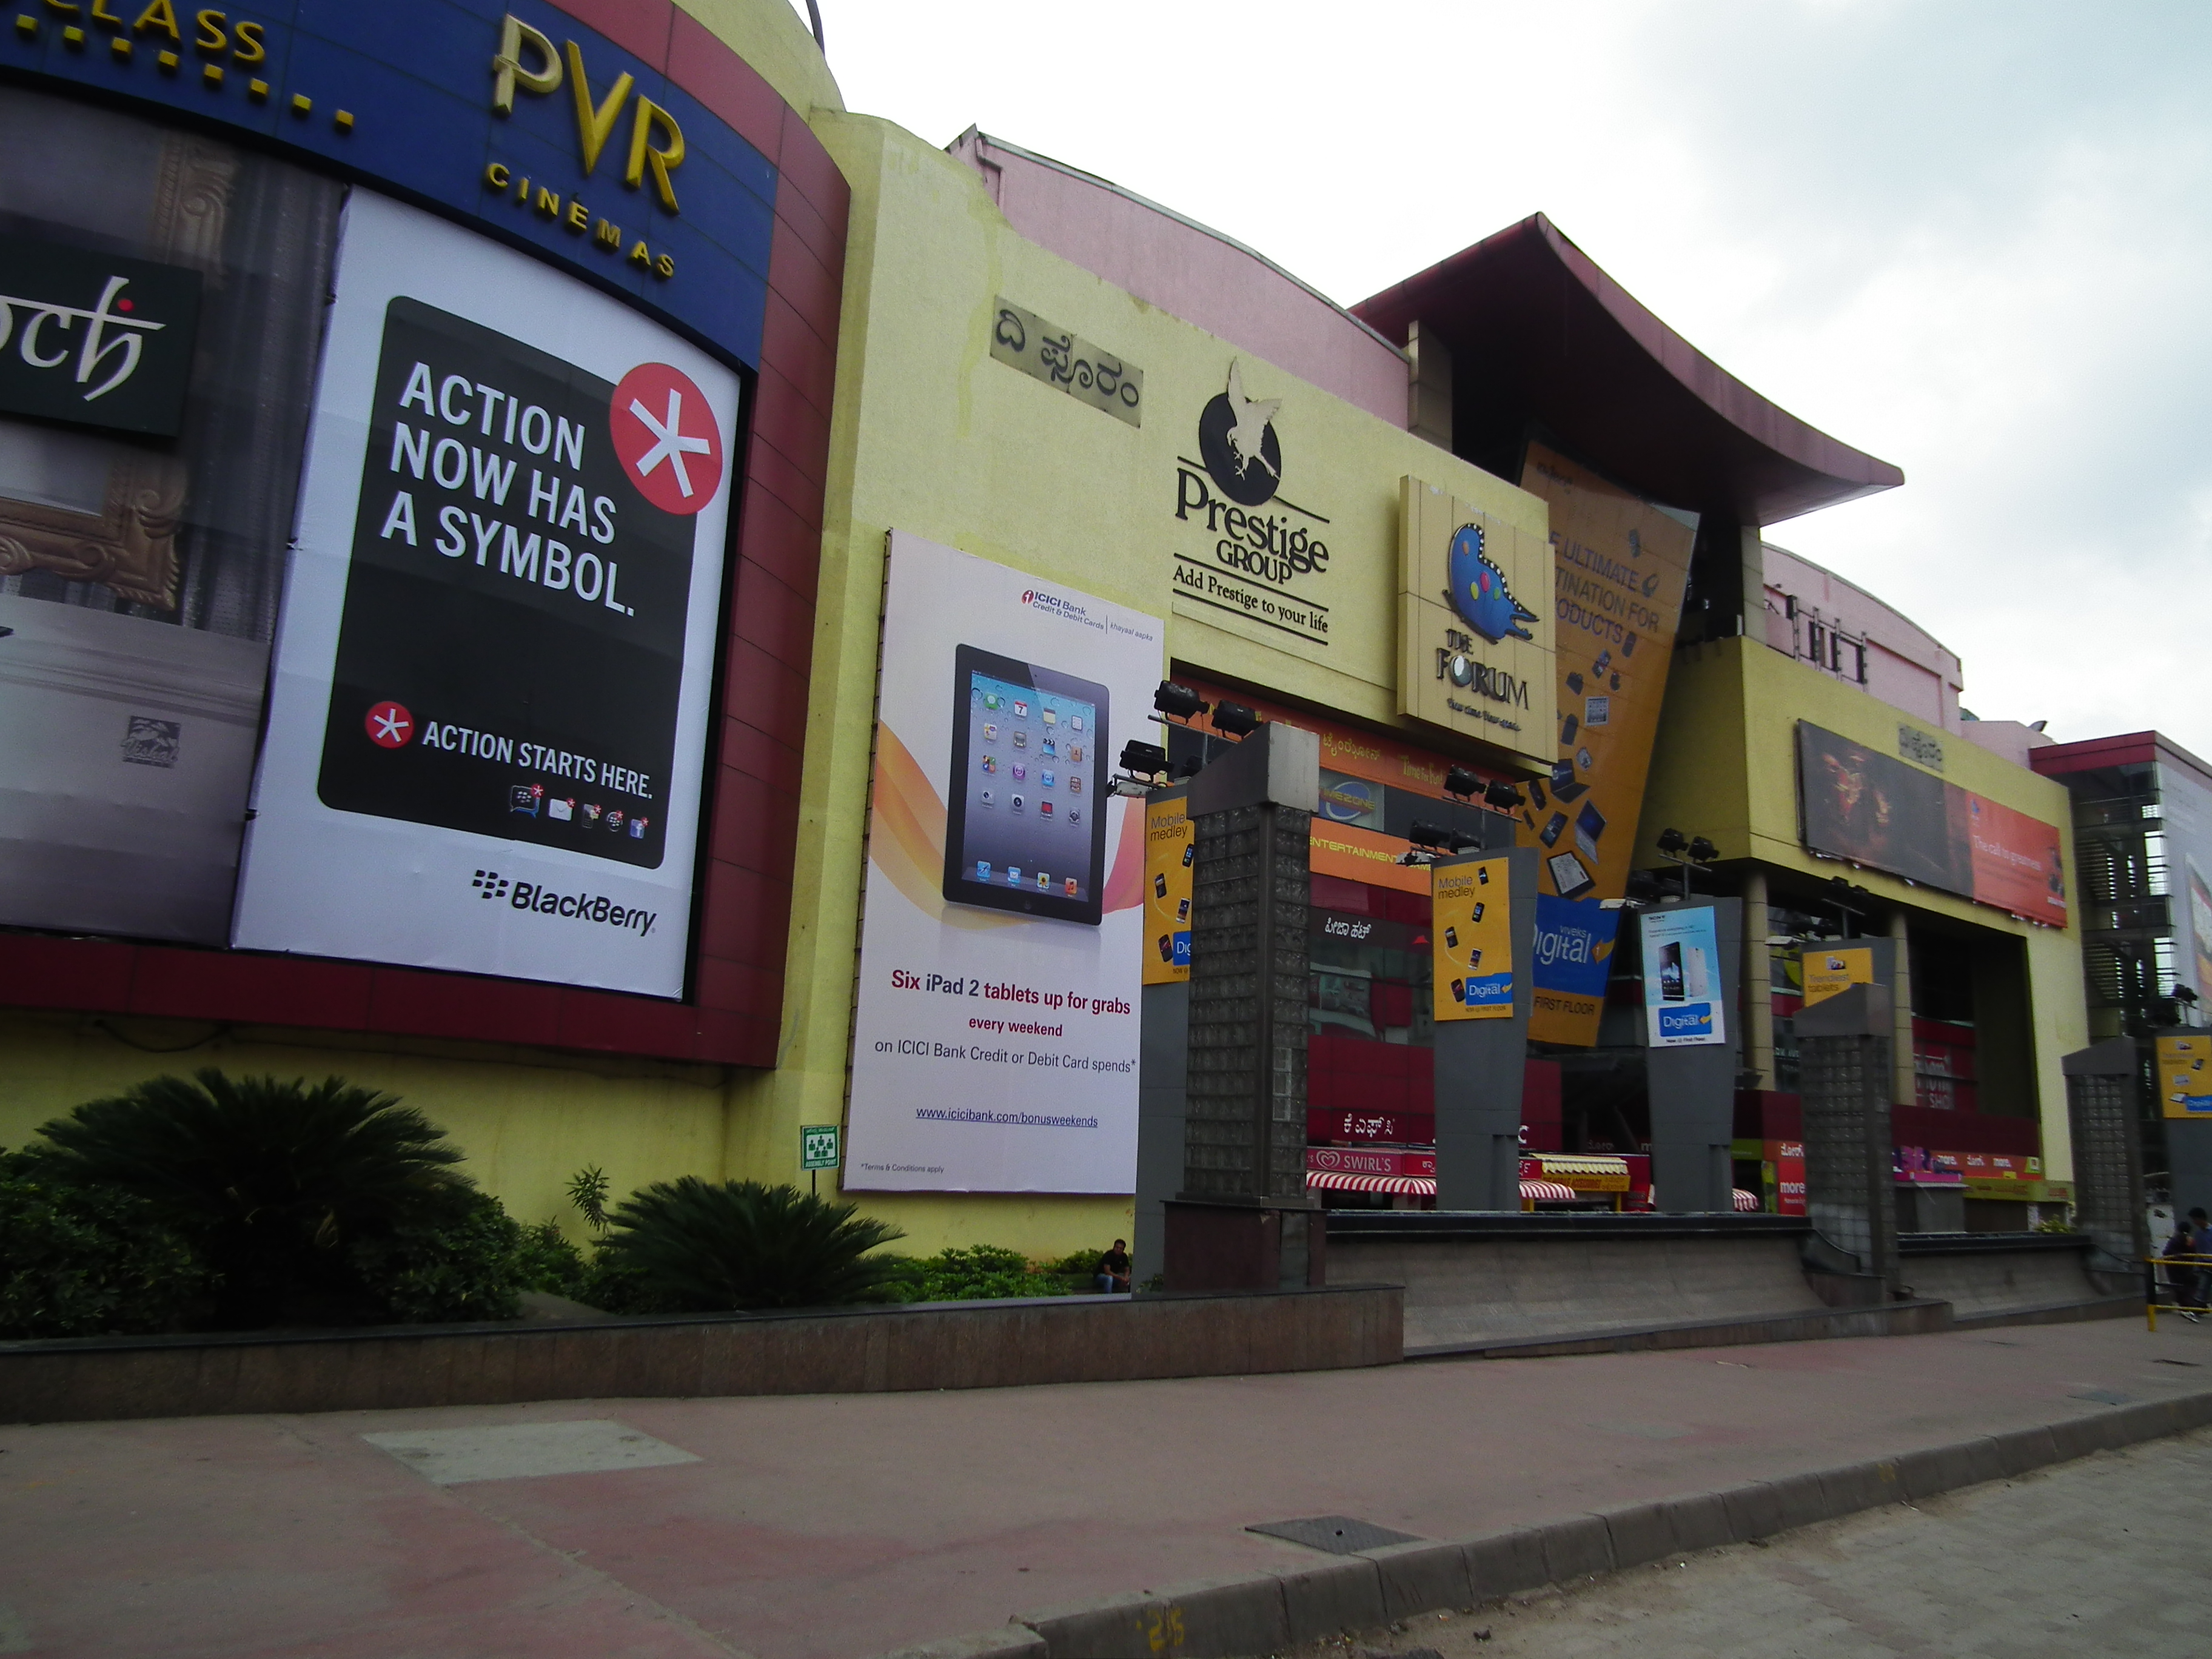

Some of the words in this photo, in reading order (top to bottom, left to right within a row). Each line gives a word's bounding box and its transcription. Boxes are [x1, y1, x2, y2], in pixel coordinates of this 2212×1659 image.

[45, 0, 265, 61] LASS
[493, 12, 684, 215] PVR
[485, 162, 675, 278] CINEMAS
[996, 308, 1025, 352] ದಿ
[399, 361, 586, 471] ACTION
[390, 421, 518, 506] NOW
[528, 469, 617, 545] HAS
[1175, 468, 1329, 574] Prestige
[380, 490, 418, 546] A
[434, 505, 635, 617] SYMBOL.
[1216, 538, 1293, 585] GROUP
[1563, 537, 1639, 591] ULTIMATE
[1034, 591, 1061, 607] ICICI
[1062, 600, 1086, 616] Bank
[1173, 565, 1204, 589] Add
[1208, 575, 1258, 609] Prestige
[1262, 598, 1275, 614] to
[1278, 608, 1305, 630] your
[1309, 611, 1328, 633] life
[1555, 566, 1626, 617] TINATION
[1627, 602, 1660, 633] FOR
[1033, 601, 1054, 614] Credit
[1063, 611, 1083, 623] Debit
[1084, 618, 1104, 630] Cards
[1555, 597, 1623, 644] ODUCTS
[1110, 622, 1134, 635] khayaal
[1134, 631, 1153, 642] aapka
[1445, 628, 1474, 655] THE
[1436, 648, 1529, 711] FORUM
[1018, 705, 1024, 714] 7
[421, 720, 512, 763] ACTION
[518, 742, 597, 783] STARTS
[601, 762, 654, 799] HERE.
[1150, 825, 1188, 842] medley
[1151, 813, 1185, 830] Mobile
[1438, 874, 1473, 889] Mobile
[1438, 885, 1476, 900] medley
[511, 881, 657, 937] BlackBerry
[1560, 925, 1587, 939] viveks
[891, 969, 920, 990] Six
[925, 974, 964, 995] iPad
[968, 979, 980, 997] 2
[984, 982, 1040, 1004] tablets
[1044, 992, 1064, 1011] up
[1067, 991, 1088, 1010] for
[1091, 997, 1131, 1015] grabs
[1469, 983, 1501, 998] Digital
[1533, 996, 1562, 1011] FIRST
[1562, 1000, 1595, 1016] FLOOR
[968, 1016, 1005, 1034] every
[1008, 1021, 1063, 1037] weekend
[1663, 1014, 1698, 1030] Digital
[874, 1041, 893, 1053] on
[897, 1039, 929, 1057] ICICI
[934, 1042, 967, 1060] Bank
[970, 1046, 1008, 1064] Credit
[1011, 1053, 1024, 1065] or
[1028, 1051, 1059, 1068] Debit
[1062, 1053, 1089, 1070] Card
[916, 1106, 1099, 1128] www.icicibank.com/bonusweekends
[891, 1164, 926, 1173] Conditions
[927, 1165, 945, 1174] apply
[1344, 1155, 1392, 1172] SWIRL'S
